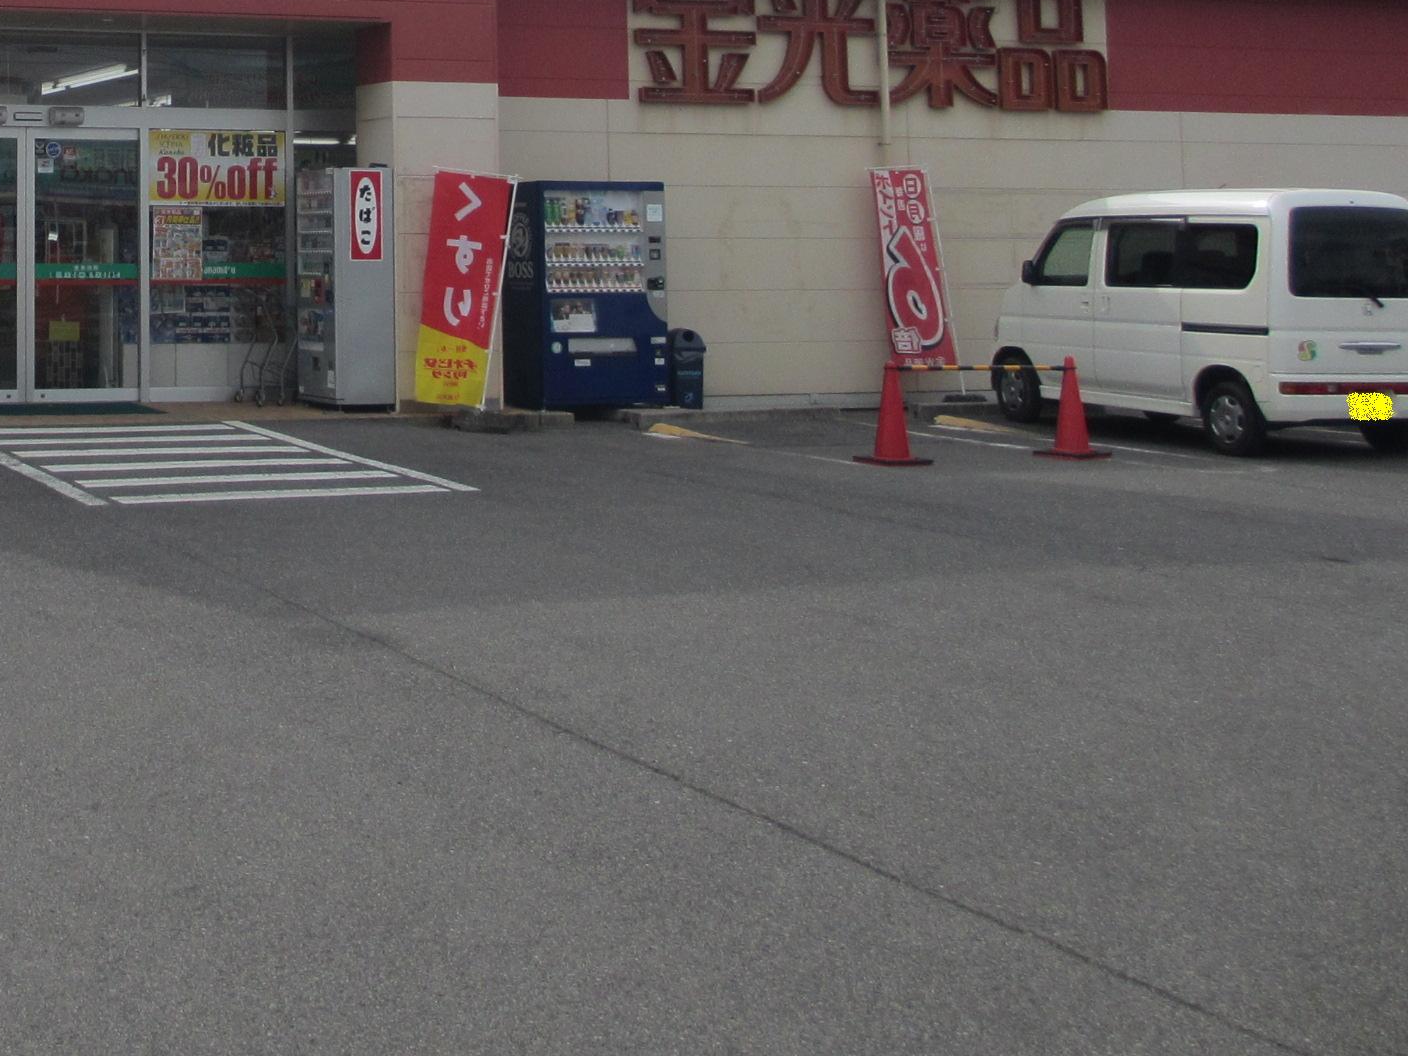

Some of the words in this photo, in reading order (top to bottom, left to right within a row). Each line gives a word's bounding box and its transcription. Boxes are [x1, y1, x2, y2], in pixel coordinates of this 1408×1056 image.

[207, 133, 278, 157] 化粧品
[156, 156, 278, 200] 30%off
